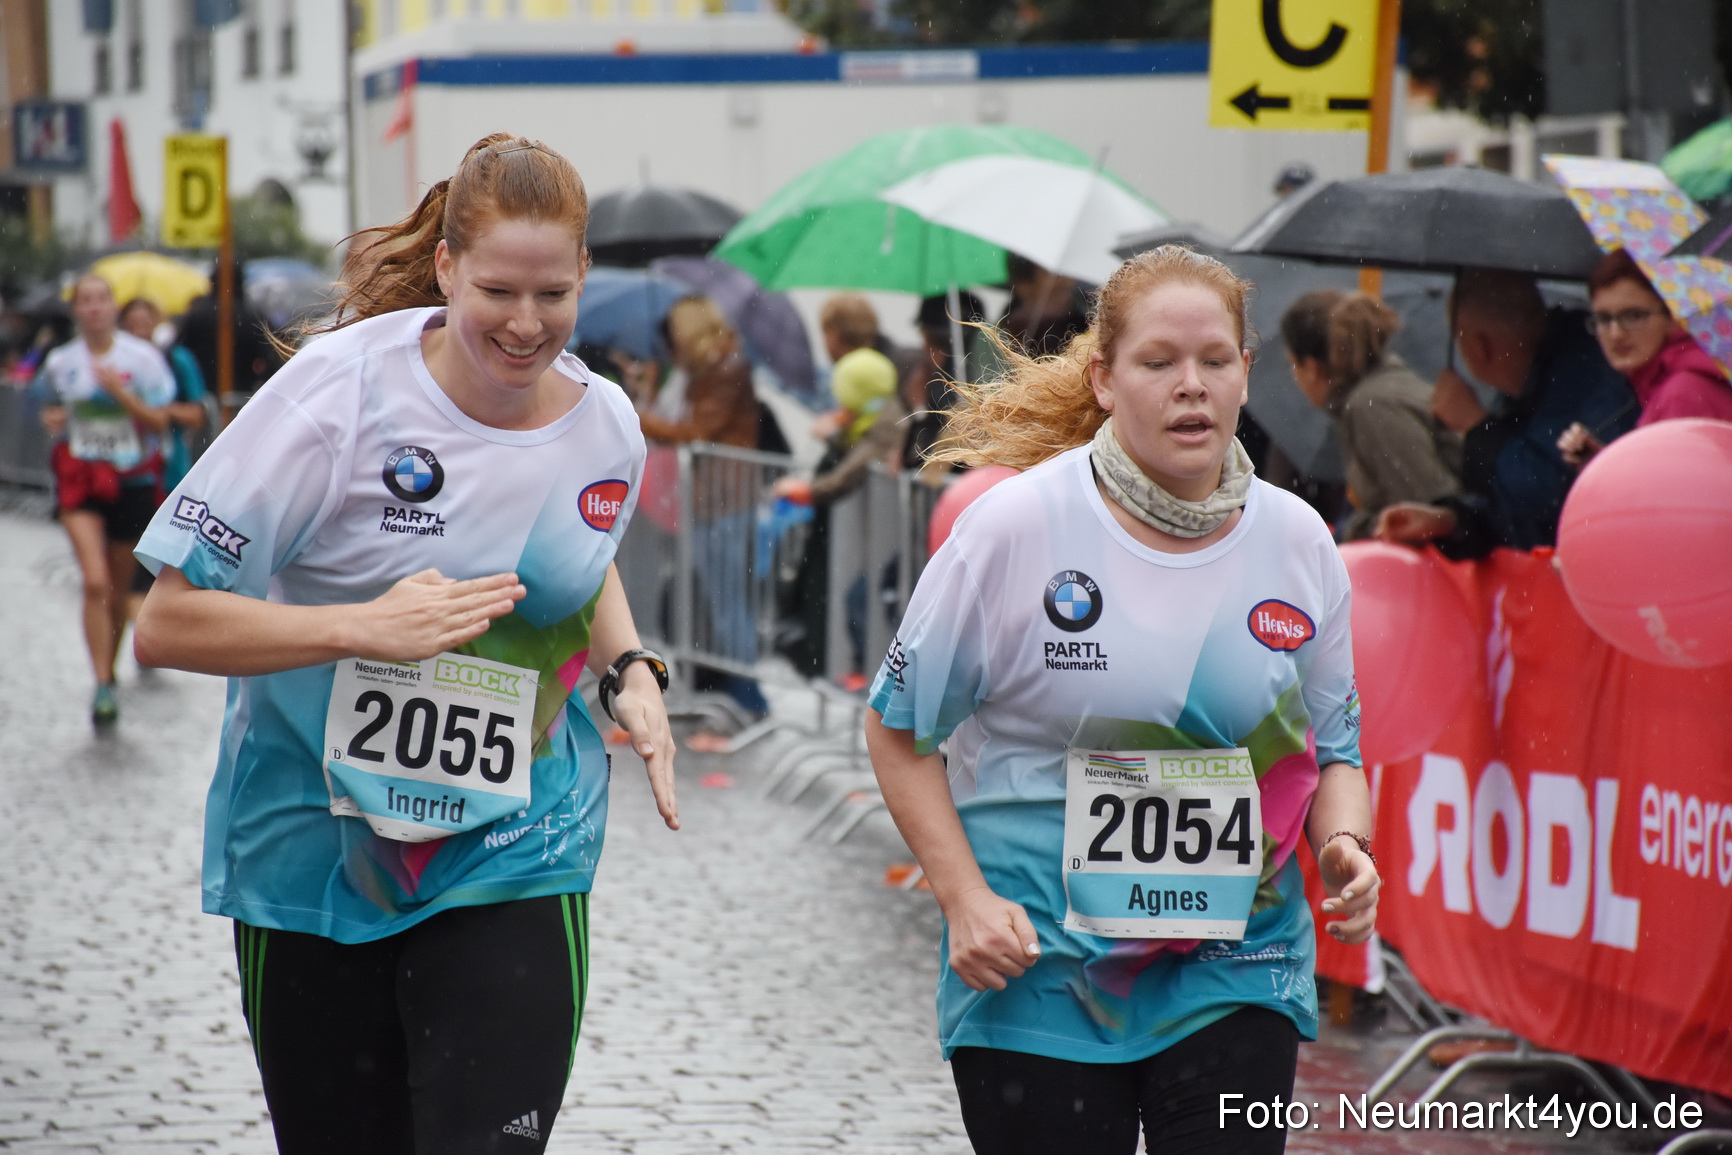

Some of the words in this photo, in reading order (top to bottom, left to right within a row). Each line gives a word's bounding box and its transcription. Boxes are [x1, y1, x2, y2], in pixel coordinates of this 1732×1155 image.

[1262, 0, 1348, 68] C
[180, 167, 212, 219] D
[387, 447, 436, 465] BMW
[587, 493, 621, 515] Her
[383, 506, 446, 525] PARTL
[173, 495, 251, 562] BOCK
[380, 521, 445, 537] Neumarkt
[1048, 572, 1097, 593] BMW
[1258, 611, 1305, 639] Hervis
[1044, 641, 1108, 658] PARTL
[355, 661, 422, 681] NeuerMarkt
[1045, 658, 1108, 671] Neumarkt
[434, 658, 521, 698] BOCK
[432, 682, 462, 693] inspired
[463, 687, 472, 696] by
[473, 691, 493, 700] smart
[347, 690, 515, 784] 2055
[1085, 767, 1150, 783] NeuerMarkt
[1160, 756, 1252, 779] BOCK
[387, 786, 466, 824] Ingrid
[1087, 793, 1255, 865] 2054
[1072, 858, 1081, 870] D
[1128, 883, 1209, 917] Agnes
[503, 1125, 541, 1140] adidas
